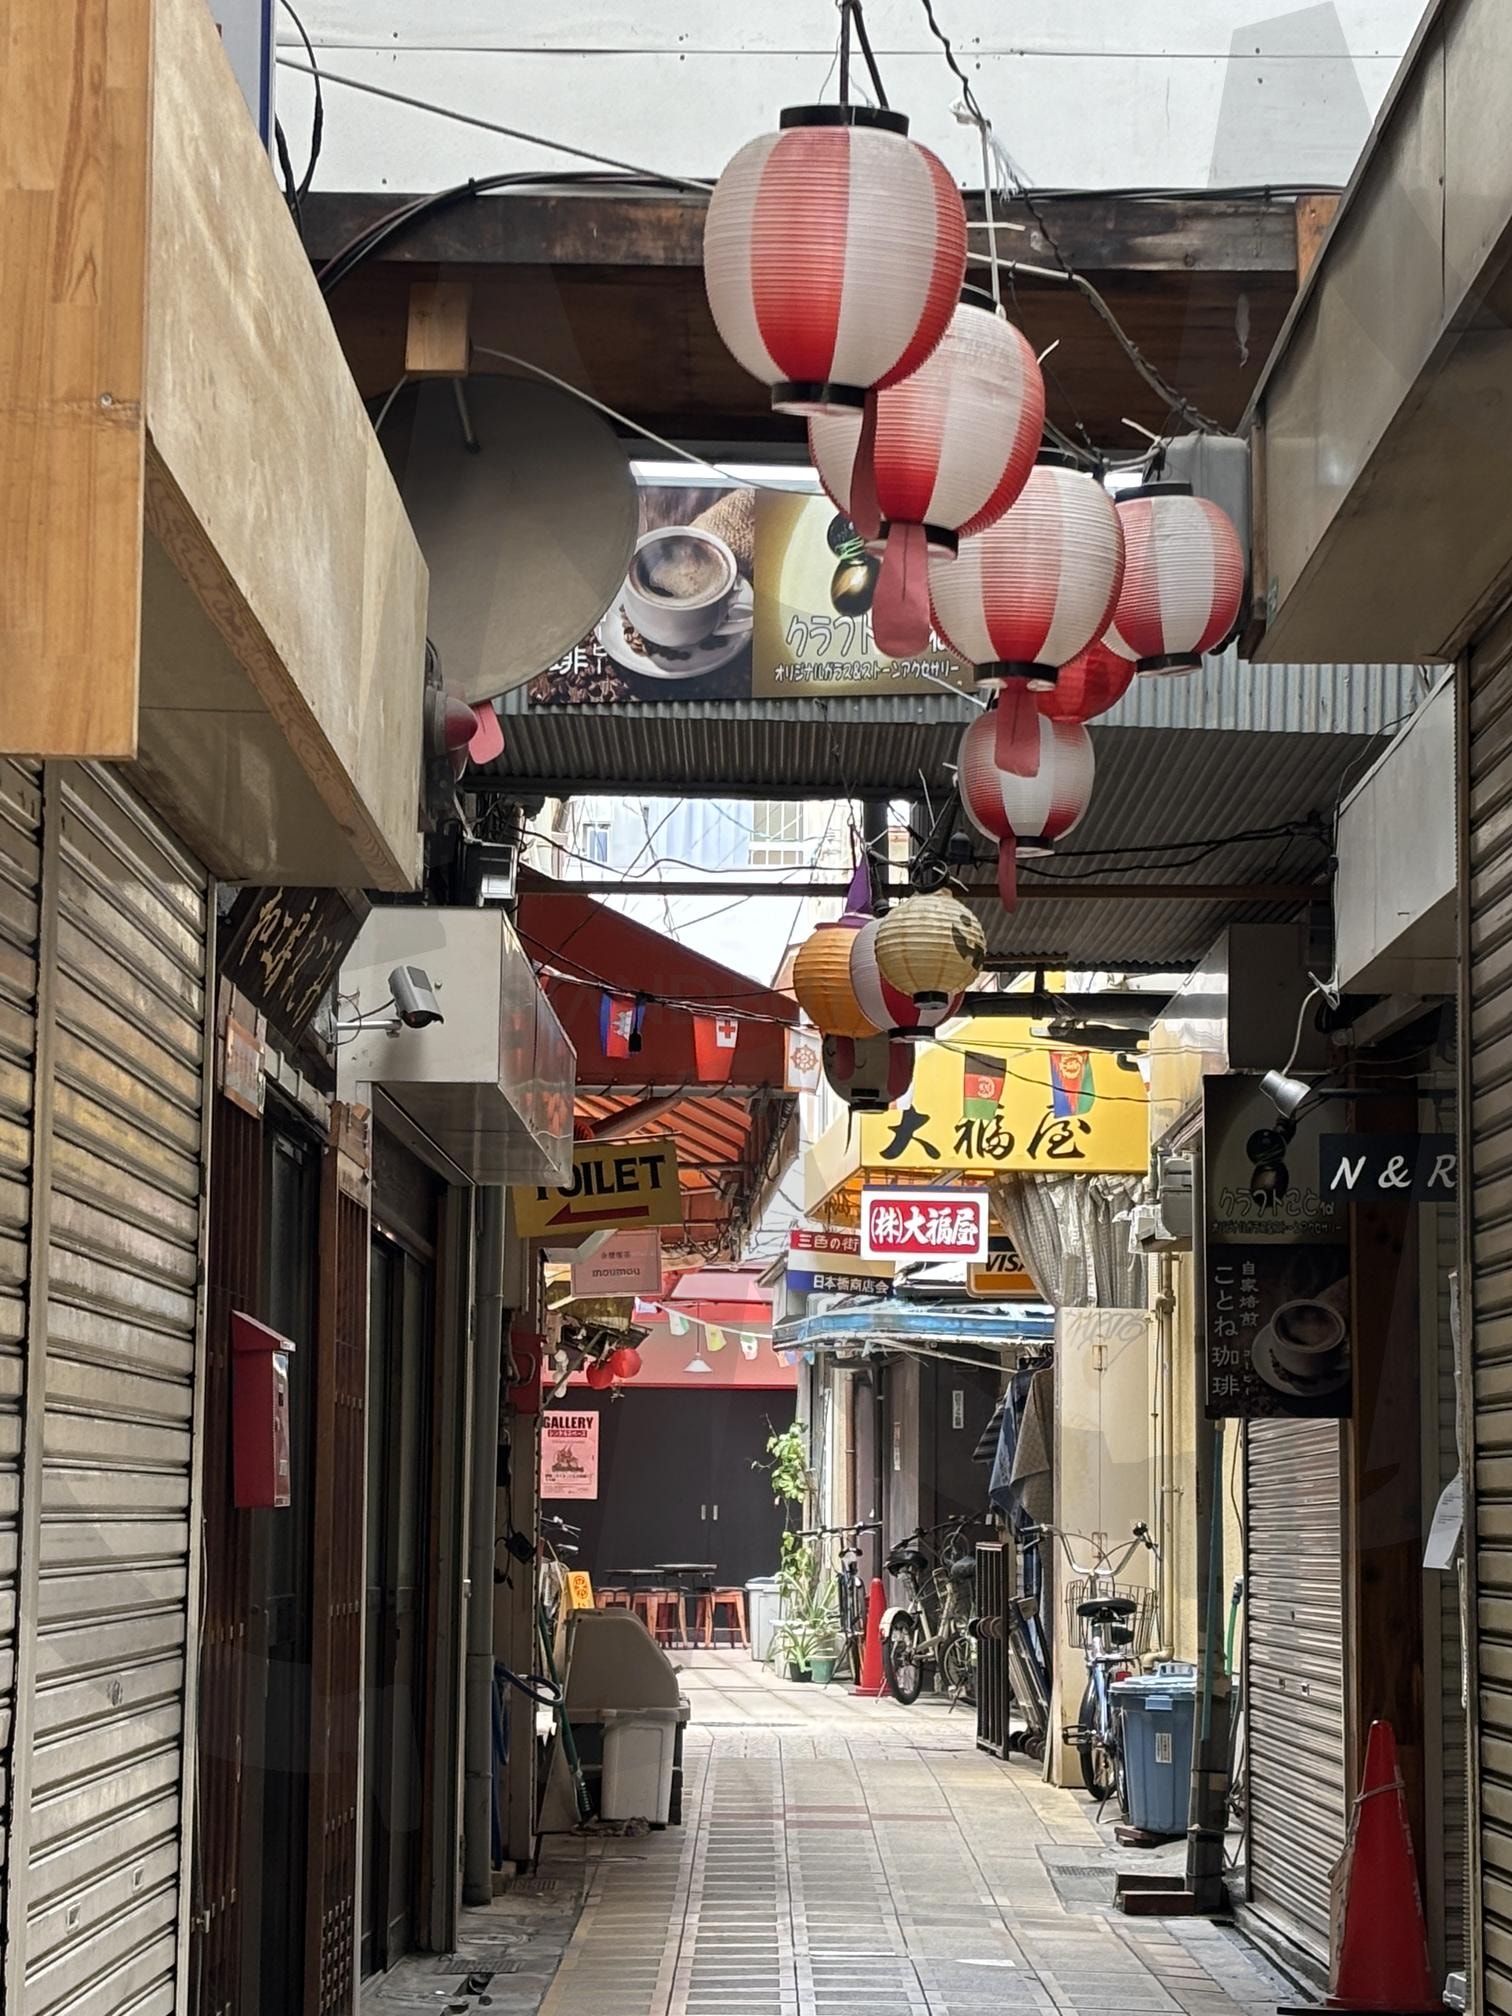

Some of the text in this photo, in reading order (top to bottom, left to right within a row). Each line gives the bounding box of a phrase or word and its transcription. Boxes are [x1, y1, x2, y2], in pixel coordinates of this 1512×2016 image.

[1330, 1156, 1367, 1190] N
[1378, 1155, 1412, 1188] &
[798, 1233, 859, 1252] 三色の街
[813, 1274, 890, 1294] 日本橋商店会
[543, 1416, 594, 1429] GALLERY
